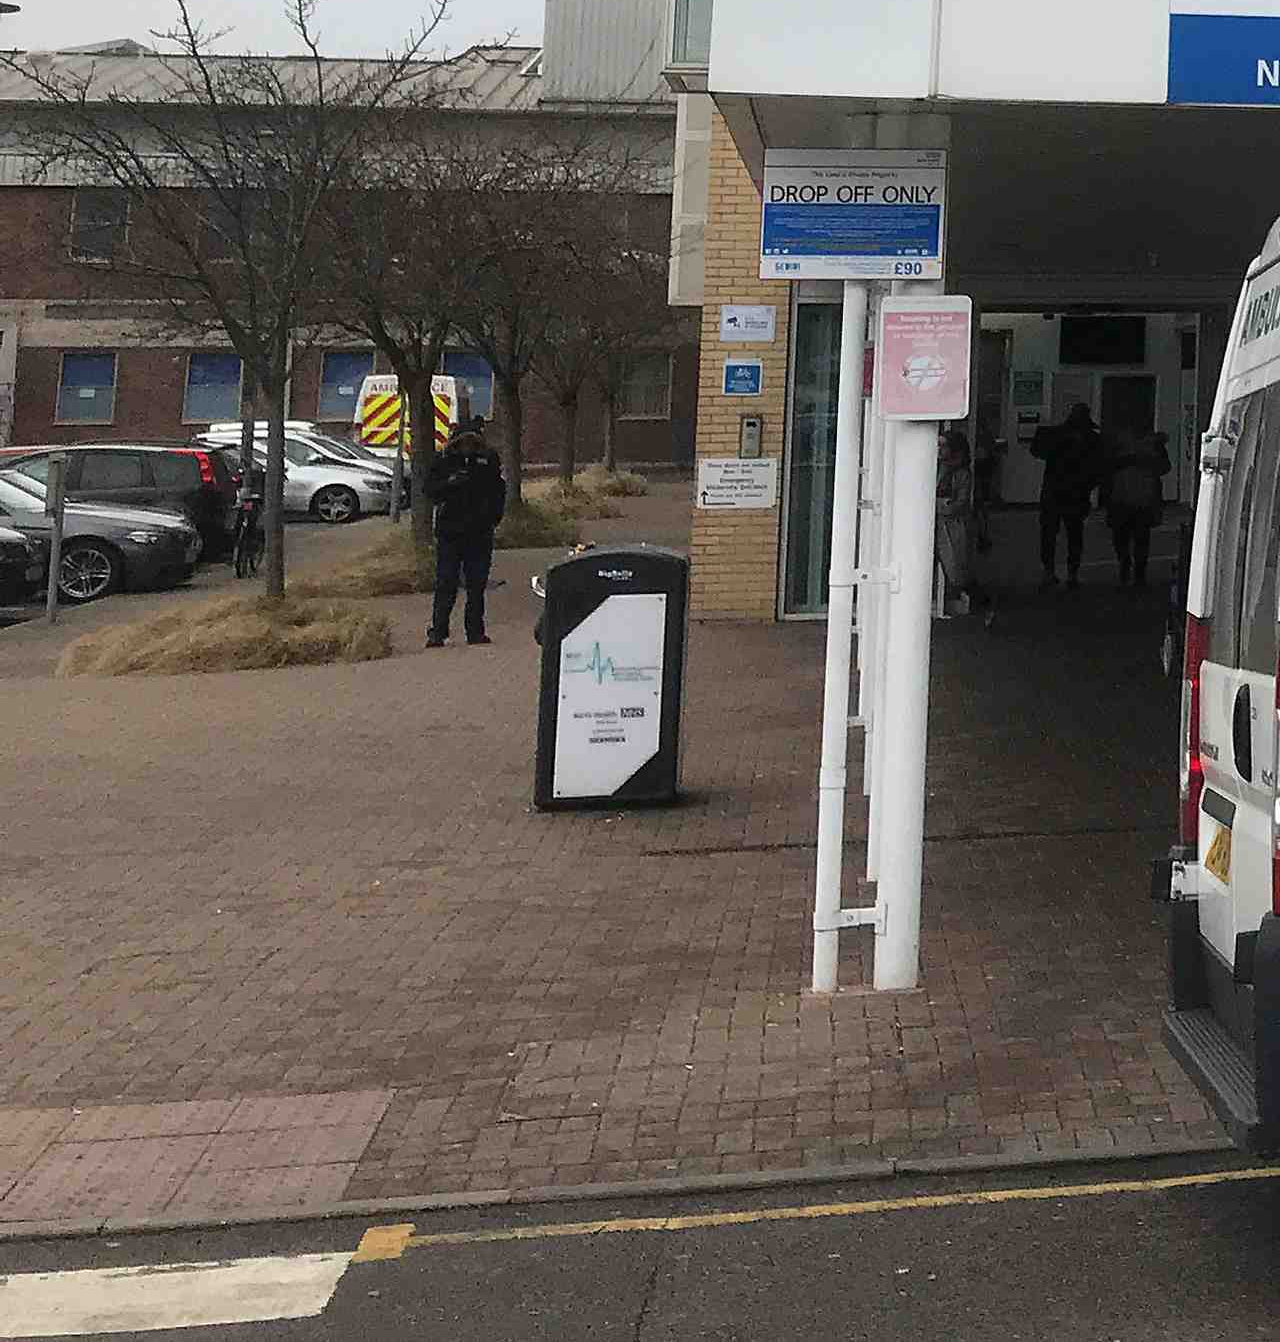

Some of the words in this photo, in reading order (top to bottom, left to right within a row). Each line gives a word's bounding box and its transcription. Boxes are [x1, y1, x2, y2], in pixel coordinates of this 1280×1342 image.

[770, 185, 829, 204] DROP
[836, 185, 874, 204] OFF
[882, 185, 938, 204] ONLY
[894, 262, 922, 276] £90
